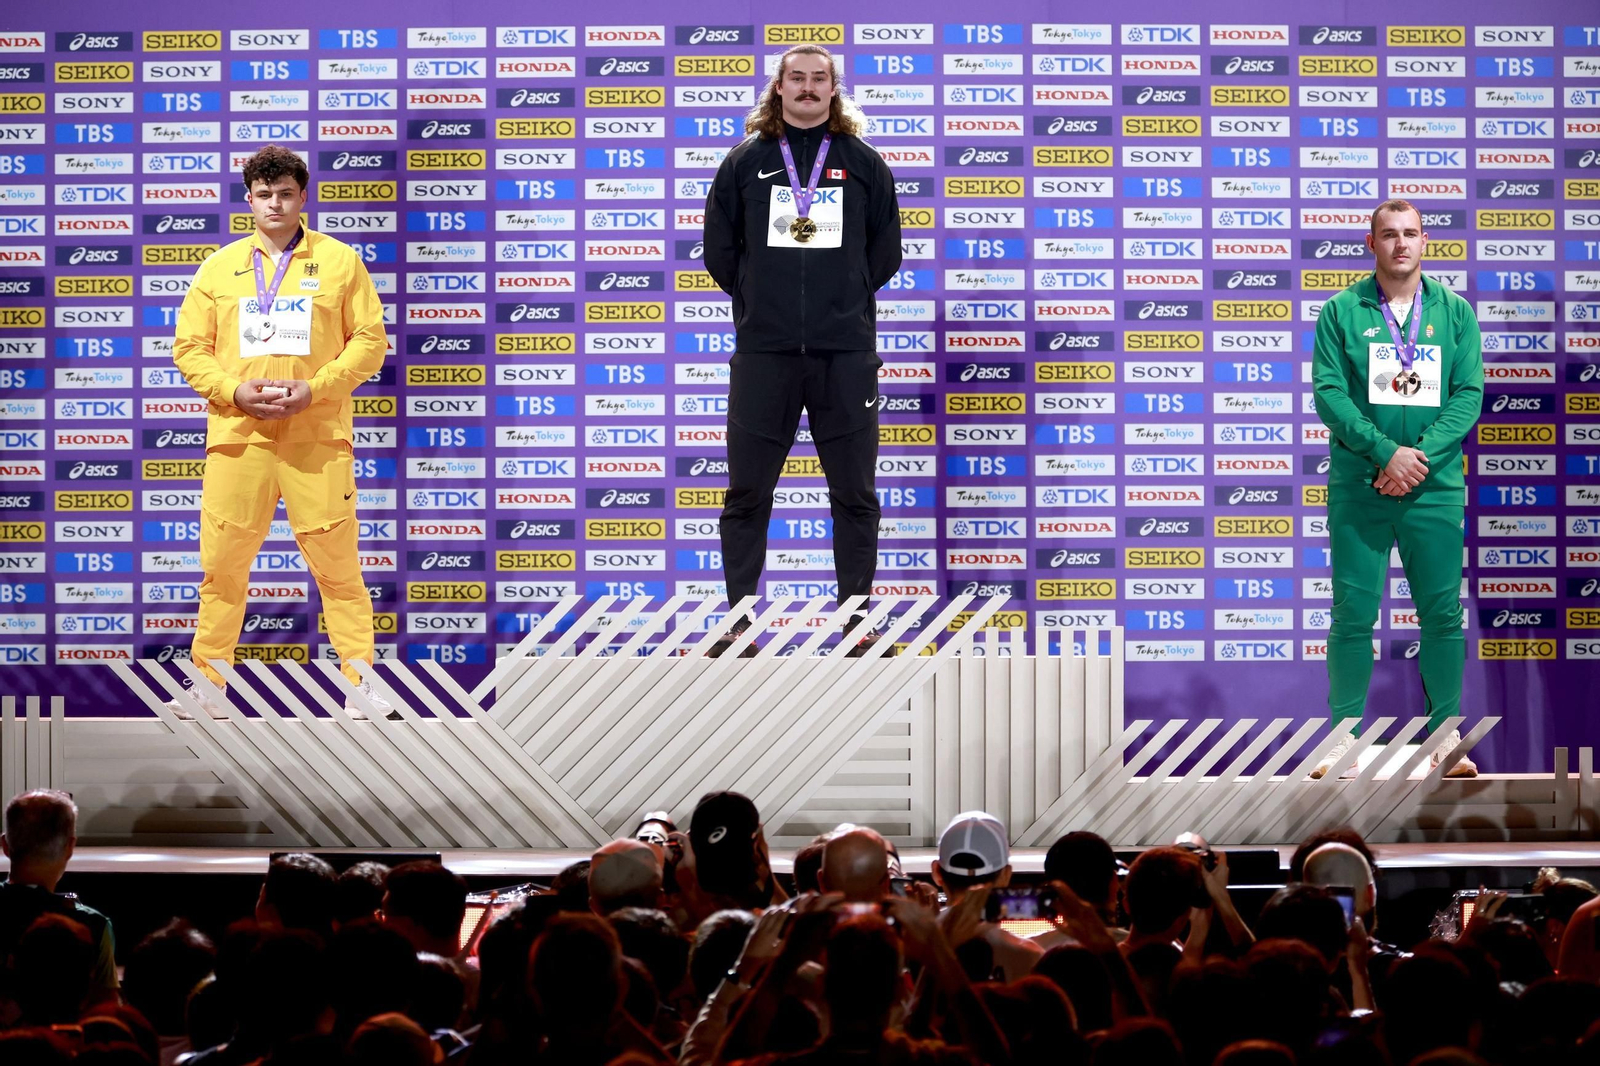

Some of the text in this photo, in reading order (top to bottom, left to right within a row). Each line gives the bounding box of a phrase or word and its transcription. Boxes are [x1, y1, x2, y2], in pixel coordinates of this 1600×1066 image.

[146, 34, 218, 48] SEIKO
[238, 34, 301, 46] SONY
[519, 30, 569, 44] TDK
[589, 31, 662, 40] HONDA
[706, 30, 739, 41] asics
[963, 25, 1002, 43] TBS
[1143, 28, 1193, 42] TDK
[1390, 29, 1462, 44] SEIKO
[1482, 31, 1545, 42] SONY
[0, 37, 44, 46] NDA
[86, 36, 119, 47] asics
[250, 61, 289, 80] TBS
[429, 61, 480, 75] TDK
[678, 58, 750, 73] SEIKO
[874, 56, 913, 74] TBS
[1124, 61, 1198, 70] HONDA
[1241, 61, 1274, 72] asics
[1302, 59, 1374, 73] SEIKO
[162, 93, 201, 111] TBS
[410, 94, 483, 103] HONDA
[527, 93, 560, 104] asics
[589, 90, 661, 104] SEIKO
[966, 88, 1016, 102] TDK
[1036, 91, 1109, 100] HONDA
[1307, 91, 1370, 102] SONY
[1407, 88, 1446, 106] TBS
[63, 97, 126, 108] SONY
[252, 124, 302, 138] TDK
[321, 126, 394, 135] HONDA
[594, 122, 656, 133] SONY
[695, 118, 735, 136] TBS
[876, 119, 927, 133] TDK
[1064, 121, 1097, 132] asics
[1126, 119, 1198, 133] SEIKO
[1219, 121, 1282, 132] SONY
[1497, 121, 1547, 135] TDK
[349, 156, 382, 167] asics
[410, 152, 482, 167] SEIKO
[504, 153, 567, 165] SONY
[975, 152, 1008, 163] asics
[1231, 148, 1270, 166] TBS
[1410, 151, 1460, 165] TDK
[0, 156, 28, 174] BS
[144, 189, 218, 198] HONDA
[516, 180, 555, 199] TBS
[948, 180, 1020, 194] SEIKO
[1042, 182, 1104, 193] SONY
[1142, 178, 1182, 196] TBS
[1391, 184, 1464, 193] HONDA
[1506, 184, 1540, 195] asics
[77, 187, 127, 202] TDK
[326, 216, 388, 228] SONY
[426, 212, 466, 230] TBS
[1234, 211, 1284, 225] TDK
[518, 244, 568, 258] TDK
[589, 246, 662, 255] HONDA
[965, 240, 1004, 258] TBS
[1331, 244, 1364, 255] asics
[1427, 242, 1464, 257] IKO
[1484, 245, 1546, 256] SONY
[85, 251, 119, 262] asics
[616, 276, 650, 287] asics
[1126, 275, 1200, 284] HONDA
[1243, 275, 1276, 286] asics
[1496, 272, 1535, 290] TBS
[275, 299, 305, 312] DK
[967, 303, 1018, 318] TDK
[1216, 303, 1288, 318] SEIKO
[62, 311, 125, 323] SONY
[409, 309, 482, 318] HONDA
[527, 308, 560, 319] asics
[1363, 327, 1381, 337] 4F
[74, 338, 114, 357] TBS
[499, 336, 571, 351] SEIKO
[594, 337, 657, 349] SONY
[949, 337, 1022, 346] HONDA
[1066, 336, 1099, 347] asics
[1127, 334, 1199, 348] SEIKO
[1498, 335, 1549, 349] TDK
[410, 368, 482, 382] SEIKO
[878, 368, 932, 377] ONDA
[1132, 366, 1195, 378] SONY
[1233, 363, 1272, 381] TBS
[76, 402, 126, 416] TDK
[354, 399, 392, 414] IKO
[414, 400, 477, 412] SONY
[516, 396, 555, 415] TBS
[887, 399, 920, 410] asics
[949, 396, 1021, 411] SEIKO
[1044, 398, 1106, 409] SONY
[1508, 399, 1541, 410] asics
[878, 427, 932, 442] EIKO
[1055, 425, 1095, 443] TBS
[1235, 427, 1286, 441] TDK
[1480, 427, 1552, 441] SEIKO
[85, 465, 118, 476] asics
[518, 460, 568, 474] TDK
[966, 456, 1006, 475] TBS
[1216, 460, 1290, 469] HONDA
[57, 494, 129, 508] SEIKO
[499, 494, 572, 503] HONDA
[617, 493, 650, 504] asics
[1058, 489, 1108, 503] TDK
[1128, 492, 1201, 500] HONDA
[1497, 486, 1537, 505] TBS
[0, 525, 44, 539] IKO
[410, 526, 483, 534] HONDA
[1156, 522, 1189, 533] asics
[1217, 519, 1289, 534] SEIKO
[74, 553, 114, 571] TBS
[438, 556, 471, 567] asics
[500, 553, 572, 568] SEIKO
[594, 555, 657, 566] SONY
[878, 552, 929, 566] TDK
[949, 554, 1022, 563] HONDA
[1500, 550, 1550, 564] TDK
[1039, 582, 1111, 597] SEIKO
[1133, 583, 1196, 594] SONY
[1234, 579, 1274, 597] TBS
[1481, 584, 1554, 592] HONDA
[77, 616, 127, 631] TDK
[261, 618, 294, 629] asics
[416, 617, 478, 628] SONY
[58, 650, 132, 659] HONDA
[1481, 642, 1553, 657] SEIKO
